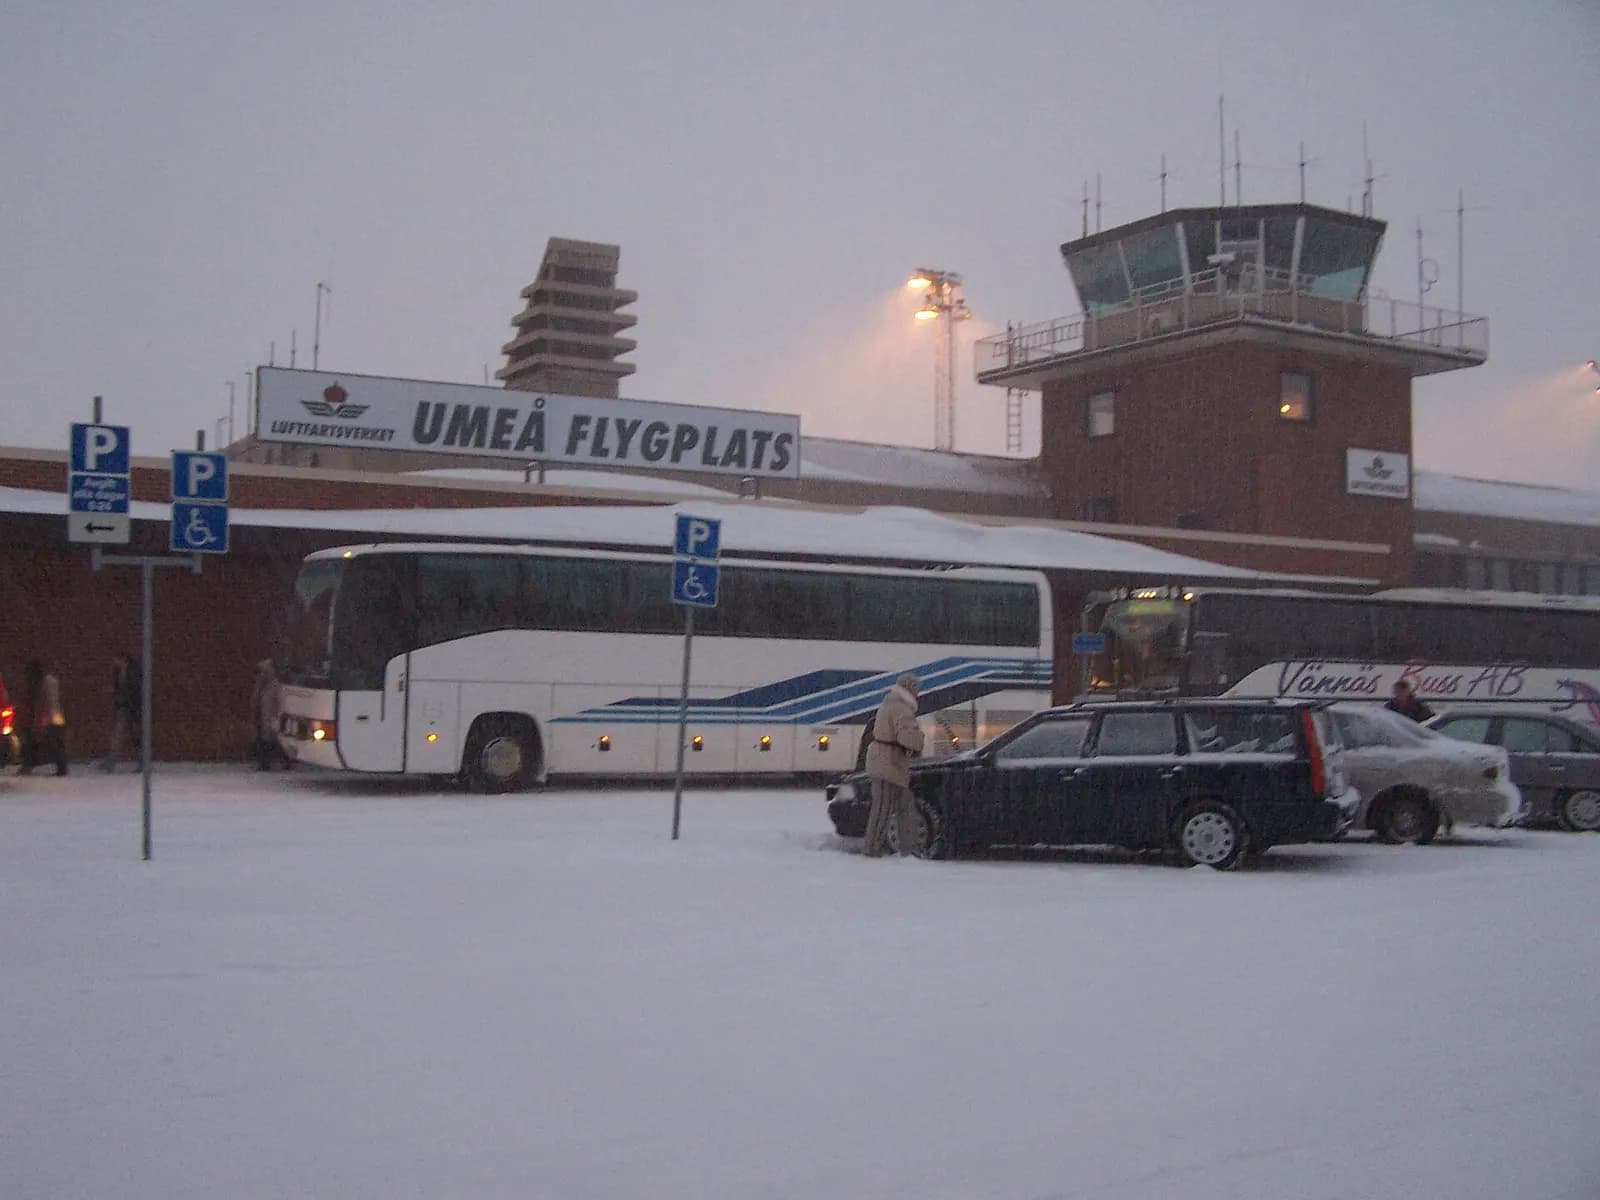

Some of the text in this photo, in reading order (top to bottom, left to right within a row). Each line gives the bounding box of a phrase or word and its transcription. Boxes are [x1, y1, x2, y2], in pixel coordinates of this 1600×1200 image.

[84, 426, 118, 470] P
[412, 396, 793, 472] UMEÅ FLYGPLATS
[188, 456, 216, 495] P
[688, 520, 711, 553] P
[1277, 659, 1382, 698] Vännäs
[1467, 660, 1529, 696] AB
